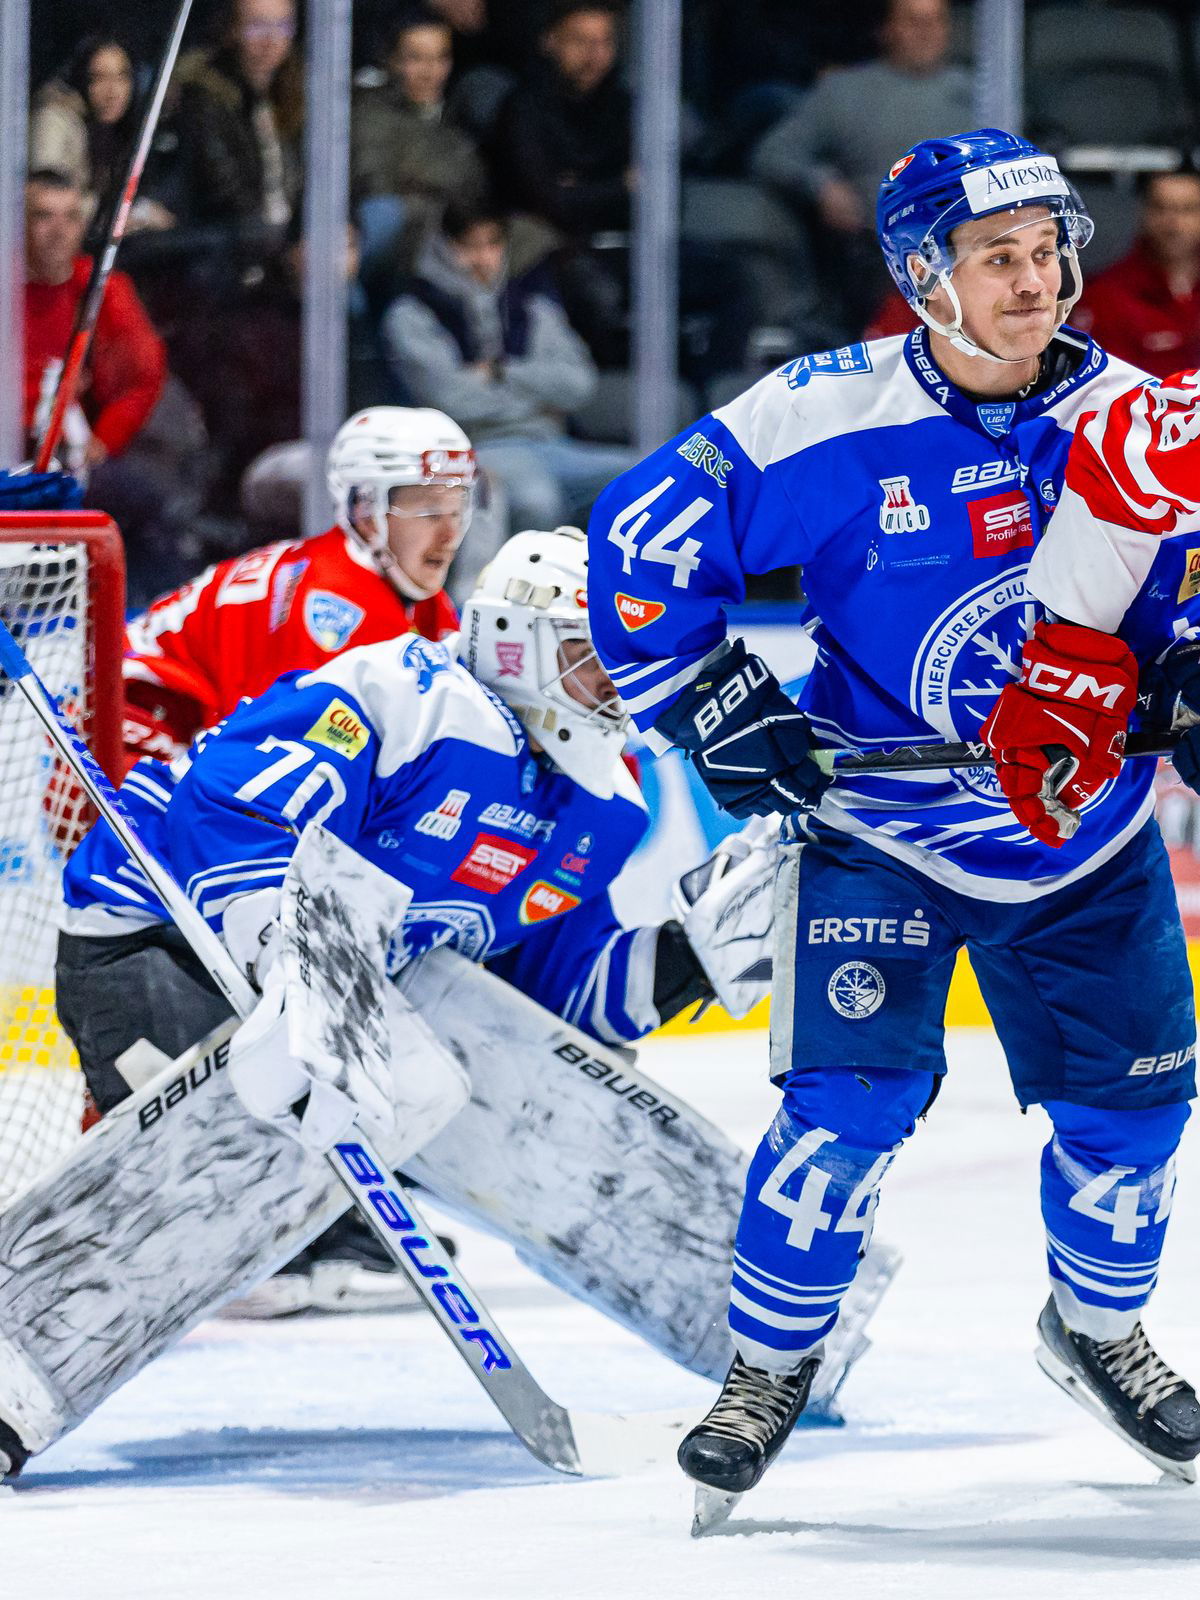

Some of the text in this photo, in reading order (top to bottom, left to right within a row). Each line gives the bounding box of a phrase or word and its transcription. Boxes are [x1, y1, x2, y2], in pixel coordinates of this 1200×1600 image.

[986, 161, 1053, 195] Artesia
[980, 406, 1005, 416] ERSTE
[987, 415, 1007, 424] LIGA
[952, 456, 1030, 488] BAU
[607, 476, 714, 589] 44
[880, 508, 926, 530] MIGO
[984, 501, 1031, 531] SE
[986, 528, 1018, 542] Profile
[620, 599, 646, 618] MOL
[927, 605, 991, 706] MIERCUREA
[693, 658, 771, 742] BAU
[1019, 658, 1126, 710] CCM
[234, 735, 348, 826] 70
[470, 843, 528, 876] SET
[808, 917, 898, 945] ERSTE
[136, 1040, 232, 1133] BAUE
[552, 1041, 683, 1129] BAUER
[757, 1126, 904, 1255] 44
[334, 1141, 514, 1376] BAUER
